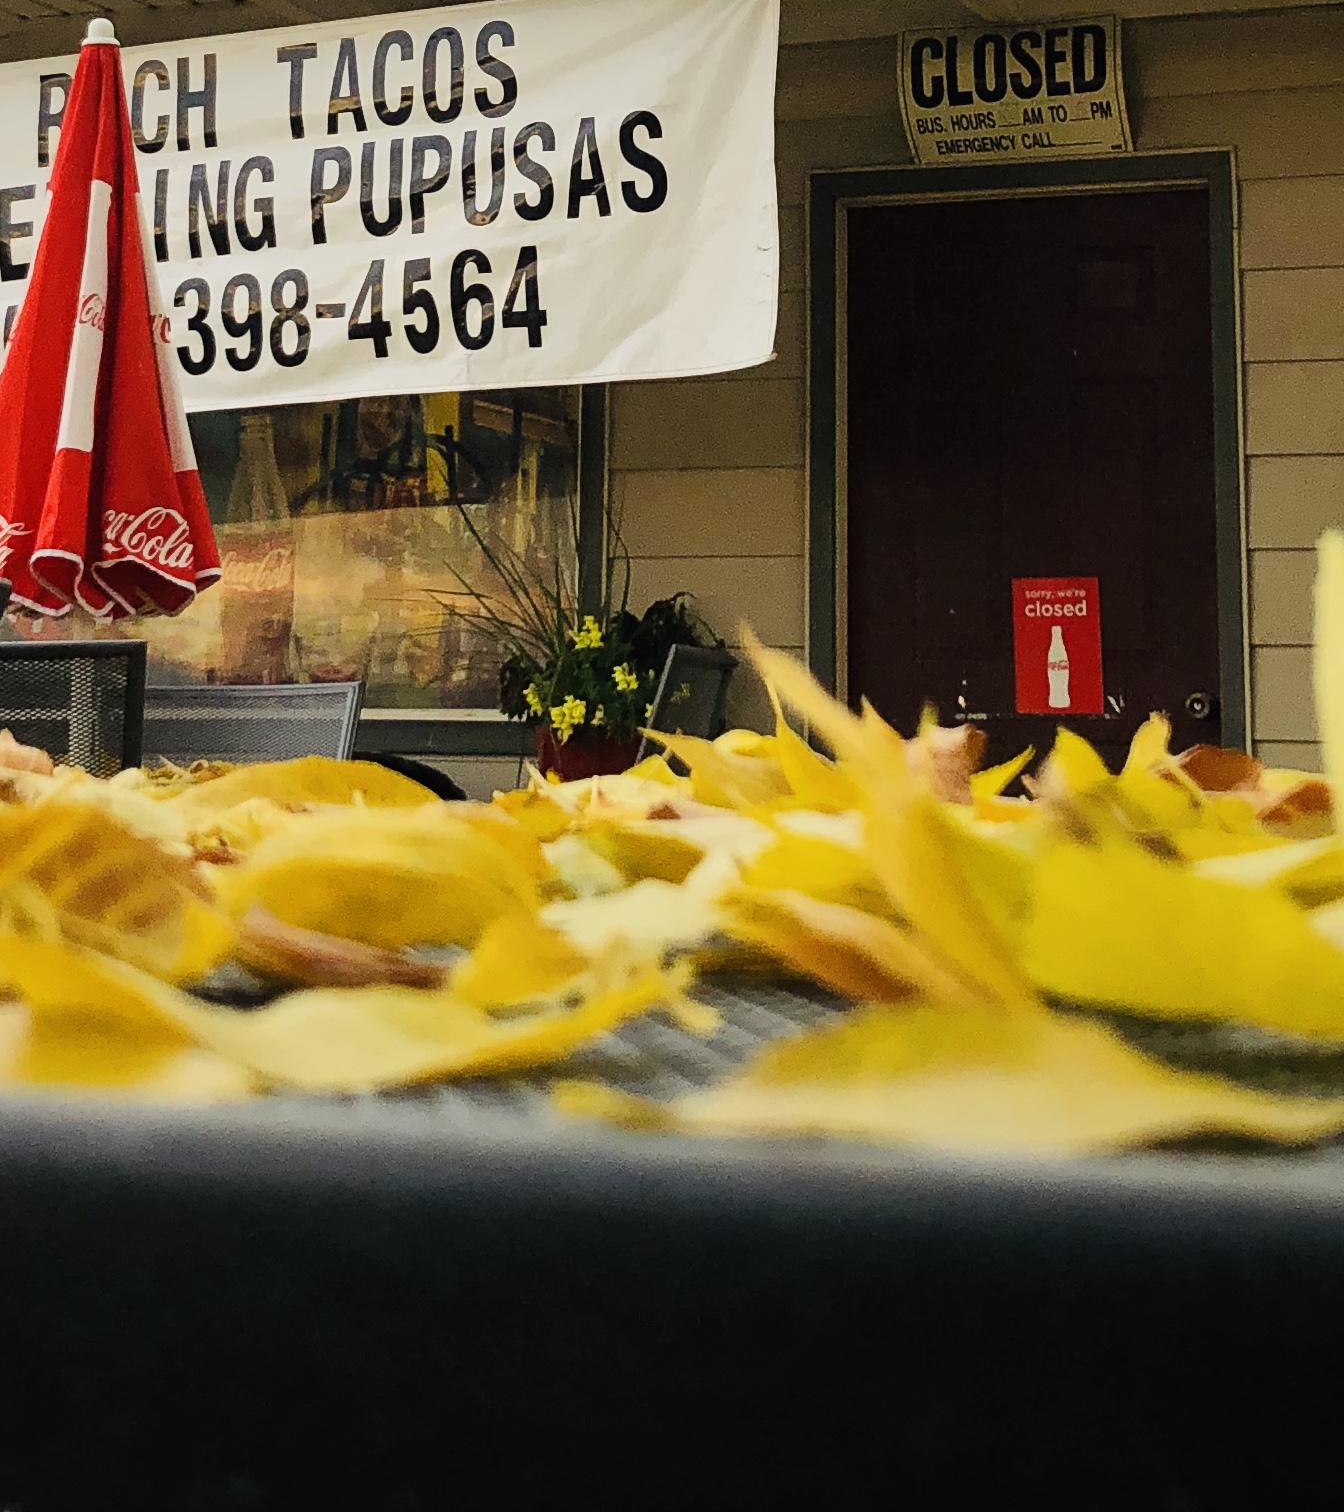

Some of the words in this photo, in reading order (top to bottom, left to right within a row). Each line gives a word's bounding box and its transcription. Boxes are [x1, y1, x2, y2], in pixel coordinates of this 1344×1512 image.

[910, 24, 1107, 109] CLOSED
[37, 53, 218, 168] RCH
[277, 20, 519, 140] TACOS
[916, 116, 948, 135] BUS.
[951, 111, 997, 133] HOURS
[1048, 104, 1068, 124] TO
[935, 134, 1016, 156] EMERGENCY
[1021, 131, 1056, 151] CALL
[311, 110, 668, 246] PUPUSAS
[1024, 599, 1087, 617] closed
[1025, 590, 1055, 600] sorry,
[1057, 588, 1086, 597] we're
